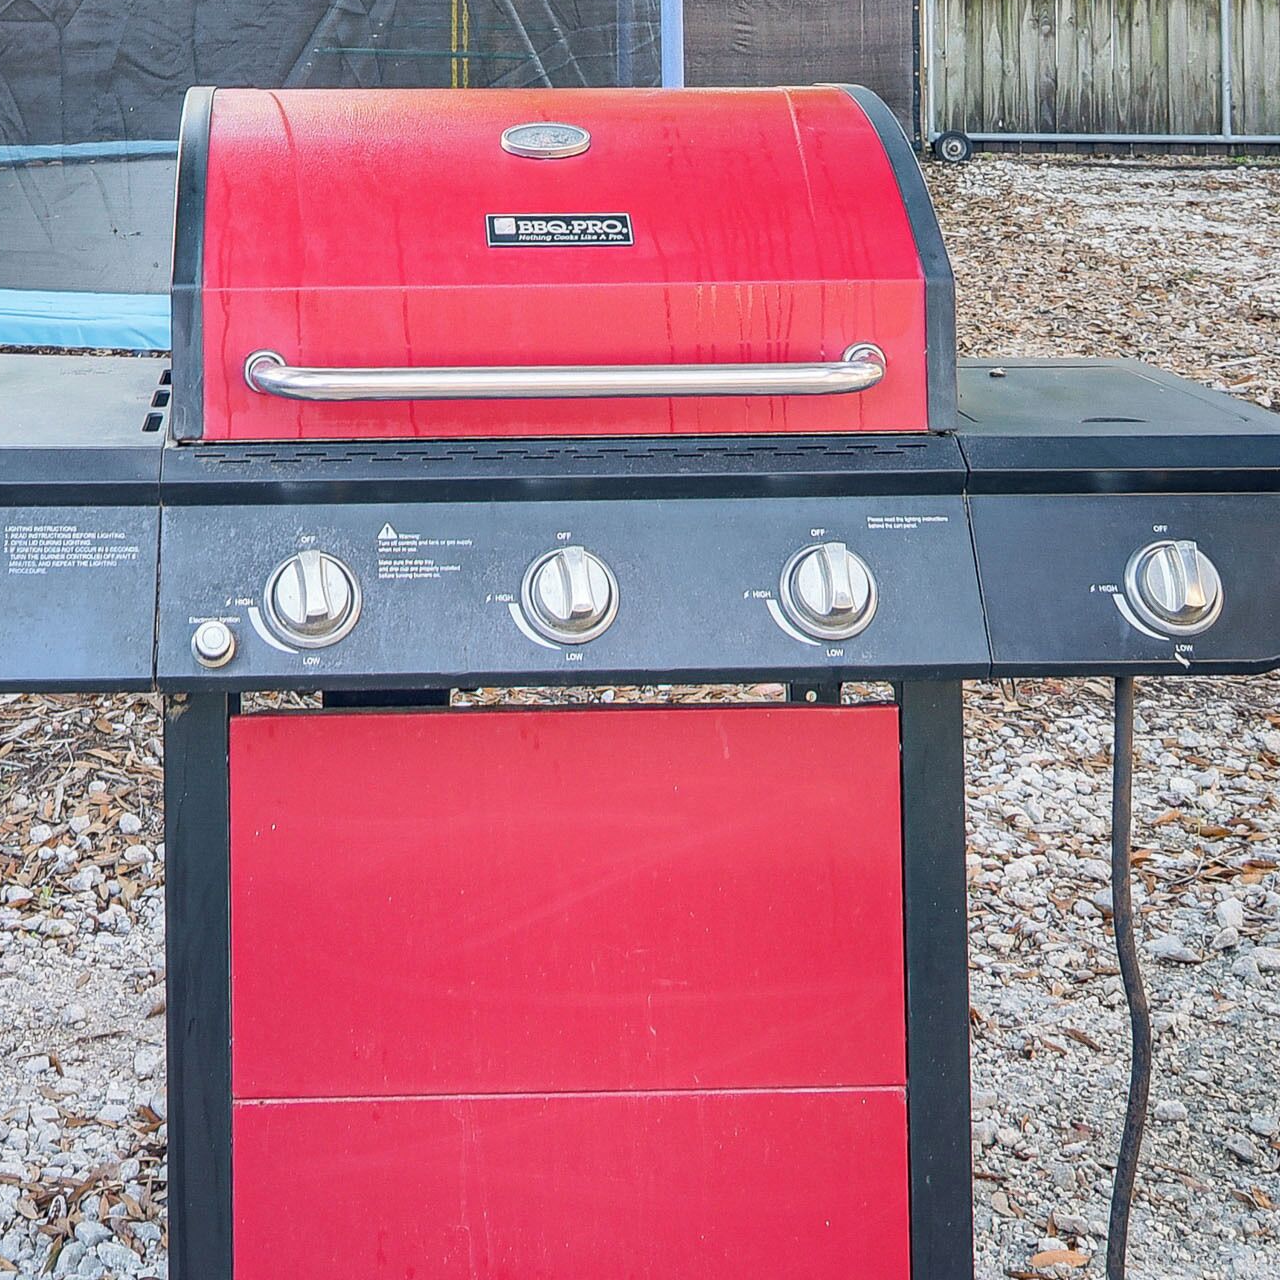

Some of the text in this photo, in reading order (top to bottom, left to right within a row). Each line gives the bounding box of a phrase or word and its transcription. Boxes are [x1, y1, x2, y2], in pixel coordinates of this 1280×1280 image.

[810, 528, 825, 537] OFF
[1152, 525, 1168, 533] OFF
[300, 536, 317, 544] OFF
[556, 532, 572, 540] OFF
[1098, 584, 1118, 593] HIGH
[495, 594, 514, 602] HIGH
[752, 590, 771, 599] HIGH
[234, 597, 254, 606] HIGH
[1175, 644, 1194, 652] LOW
[565, 653, 584, 661] LOW
[826, 649, 844, 657] LOW
[302, 656, 321, 665] LOW
